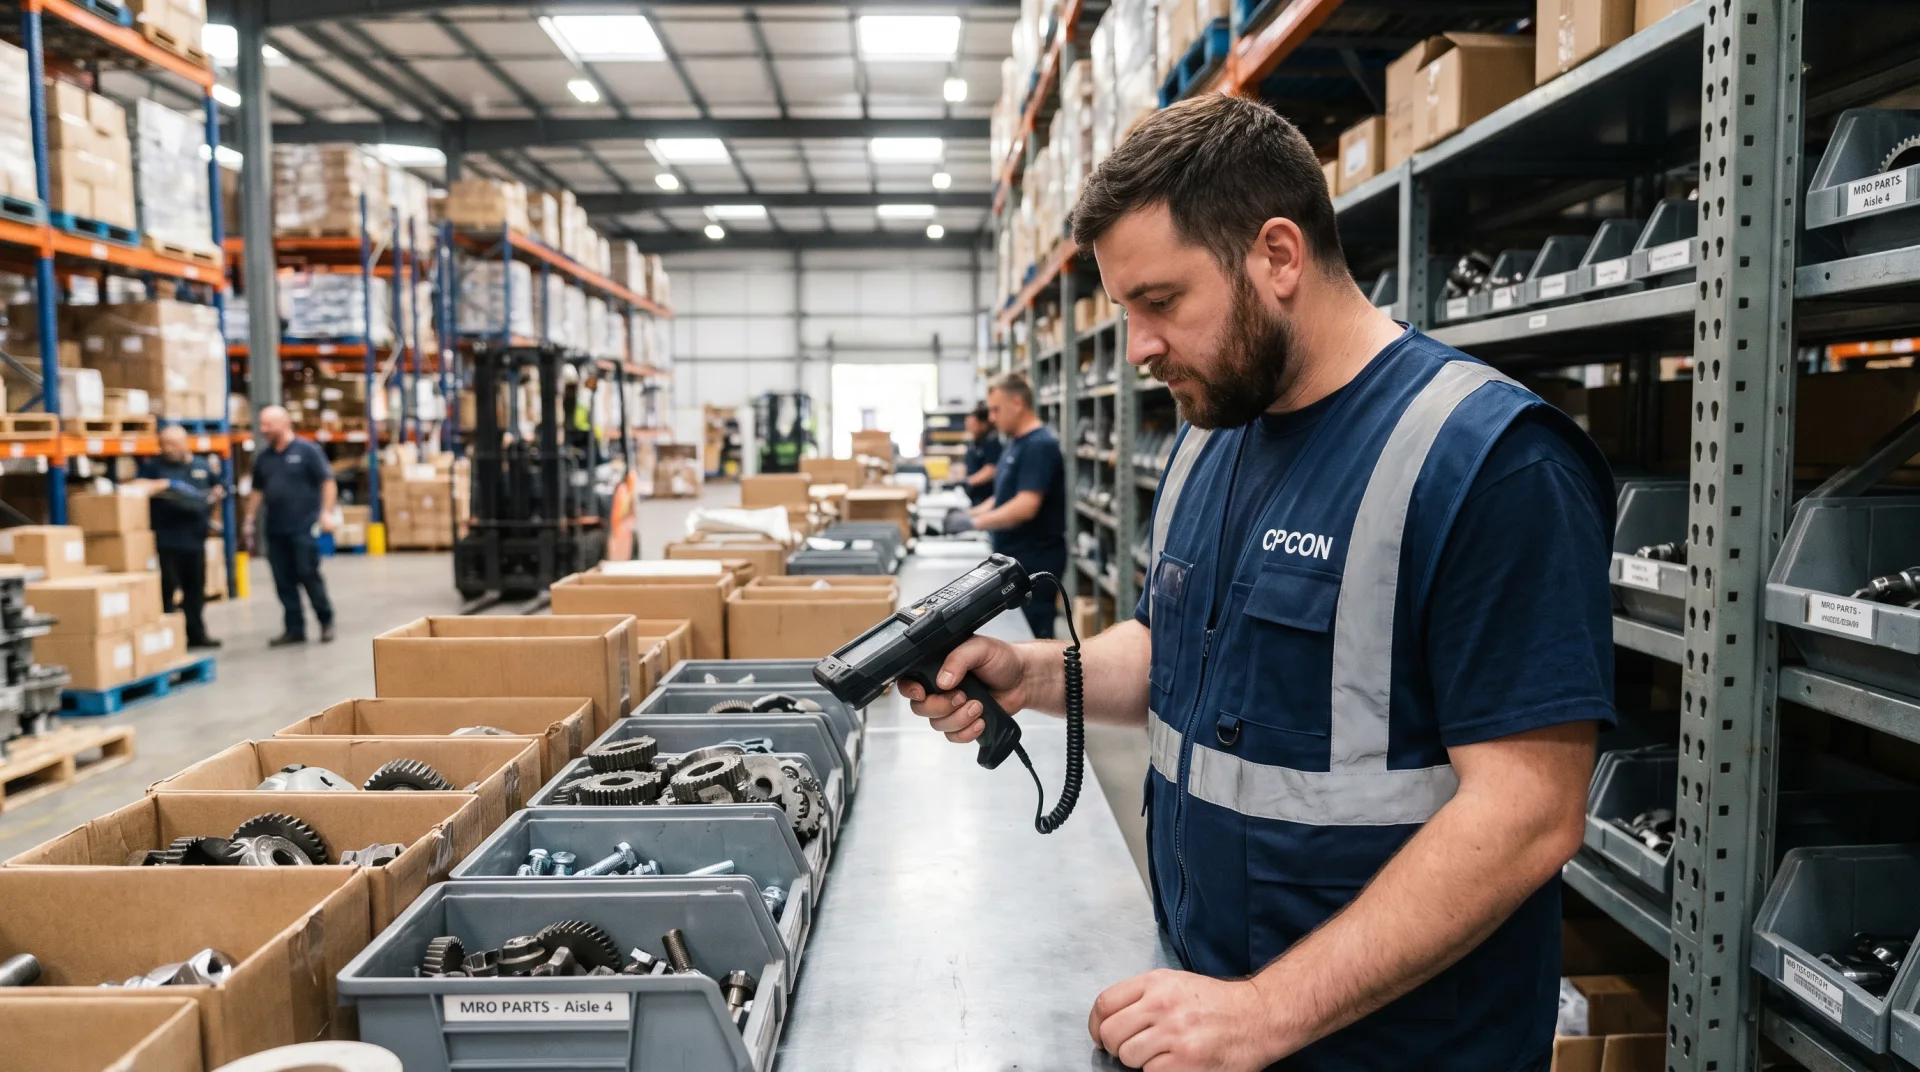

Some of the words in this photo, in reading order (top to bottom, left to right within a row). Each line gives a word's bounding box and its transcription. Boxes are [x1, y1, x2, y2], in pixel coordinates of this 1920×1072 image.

[1853, 183, 1873, 196] MRO
[1863, 195, 1883, 208] Aisle
[1885, 193, 1890, 202] 4
[1262, 529, 1334, 561] CPCON
[1821, 601, 1835, 610] MRO
[1837, 604, 1857, 615] PARTS
[460, 1001, 497, 1013] MRO
[502, 1001, 550, 1013] PARTS
[564, 1001, 600, 1013] Aisle
[604, 1001, 613, 1013] 4
